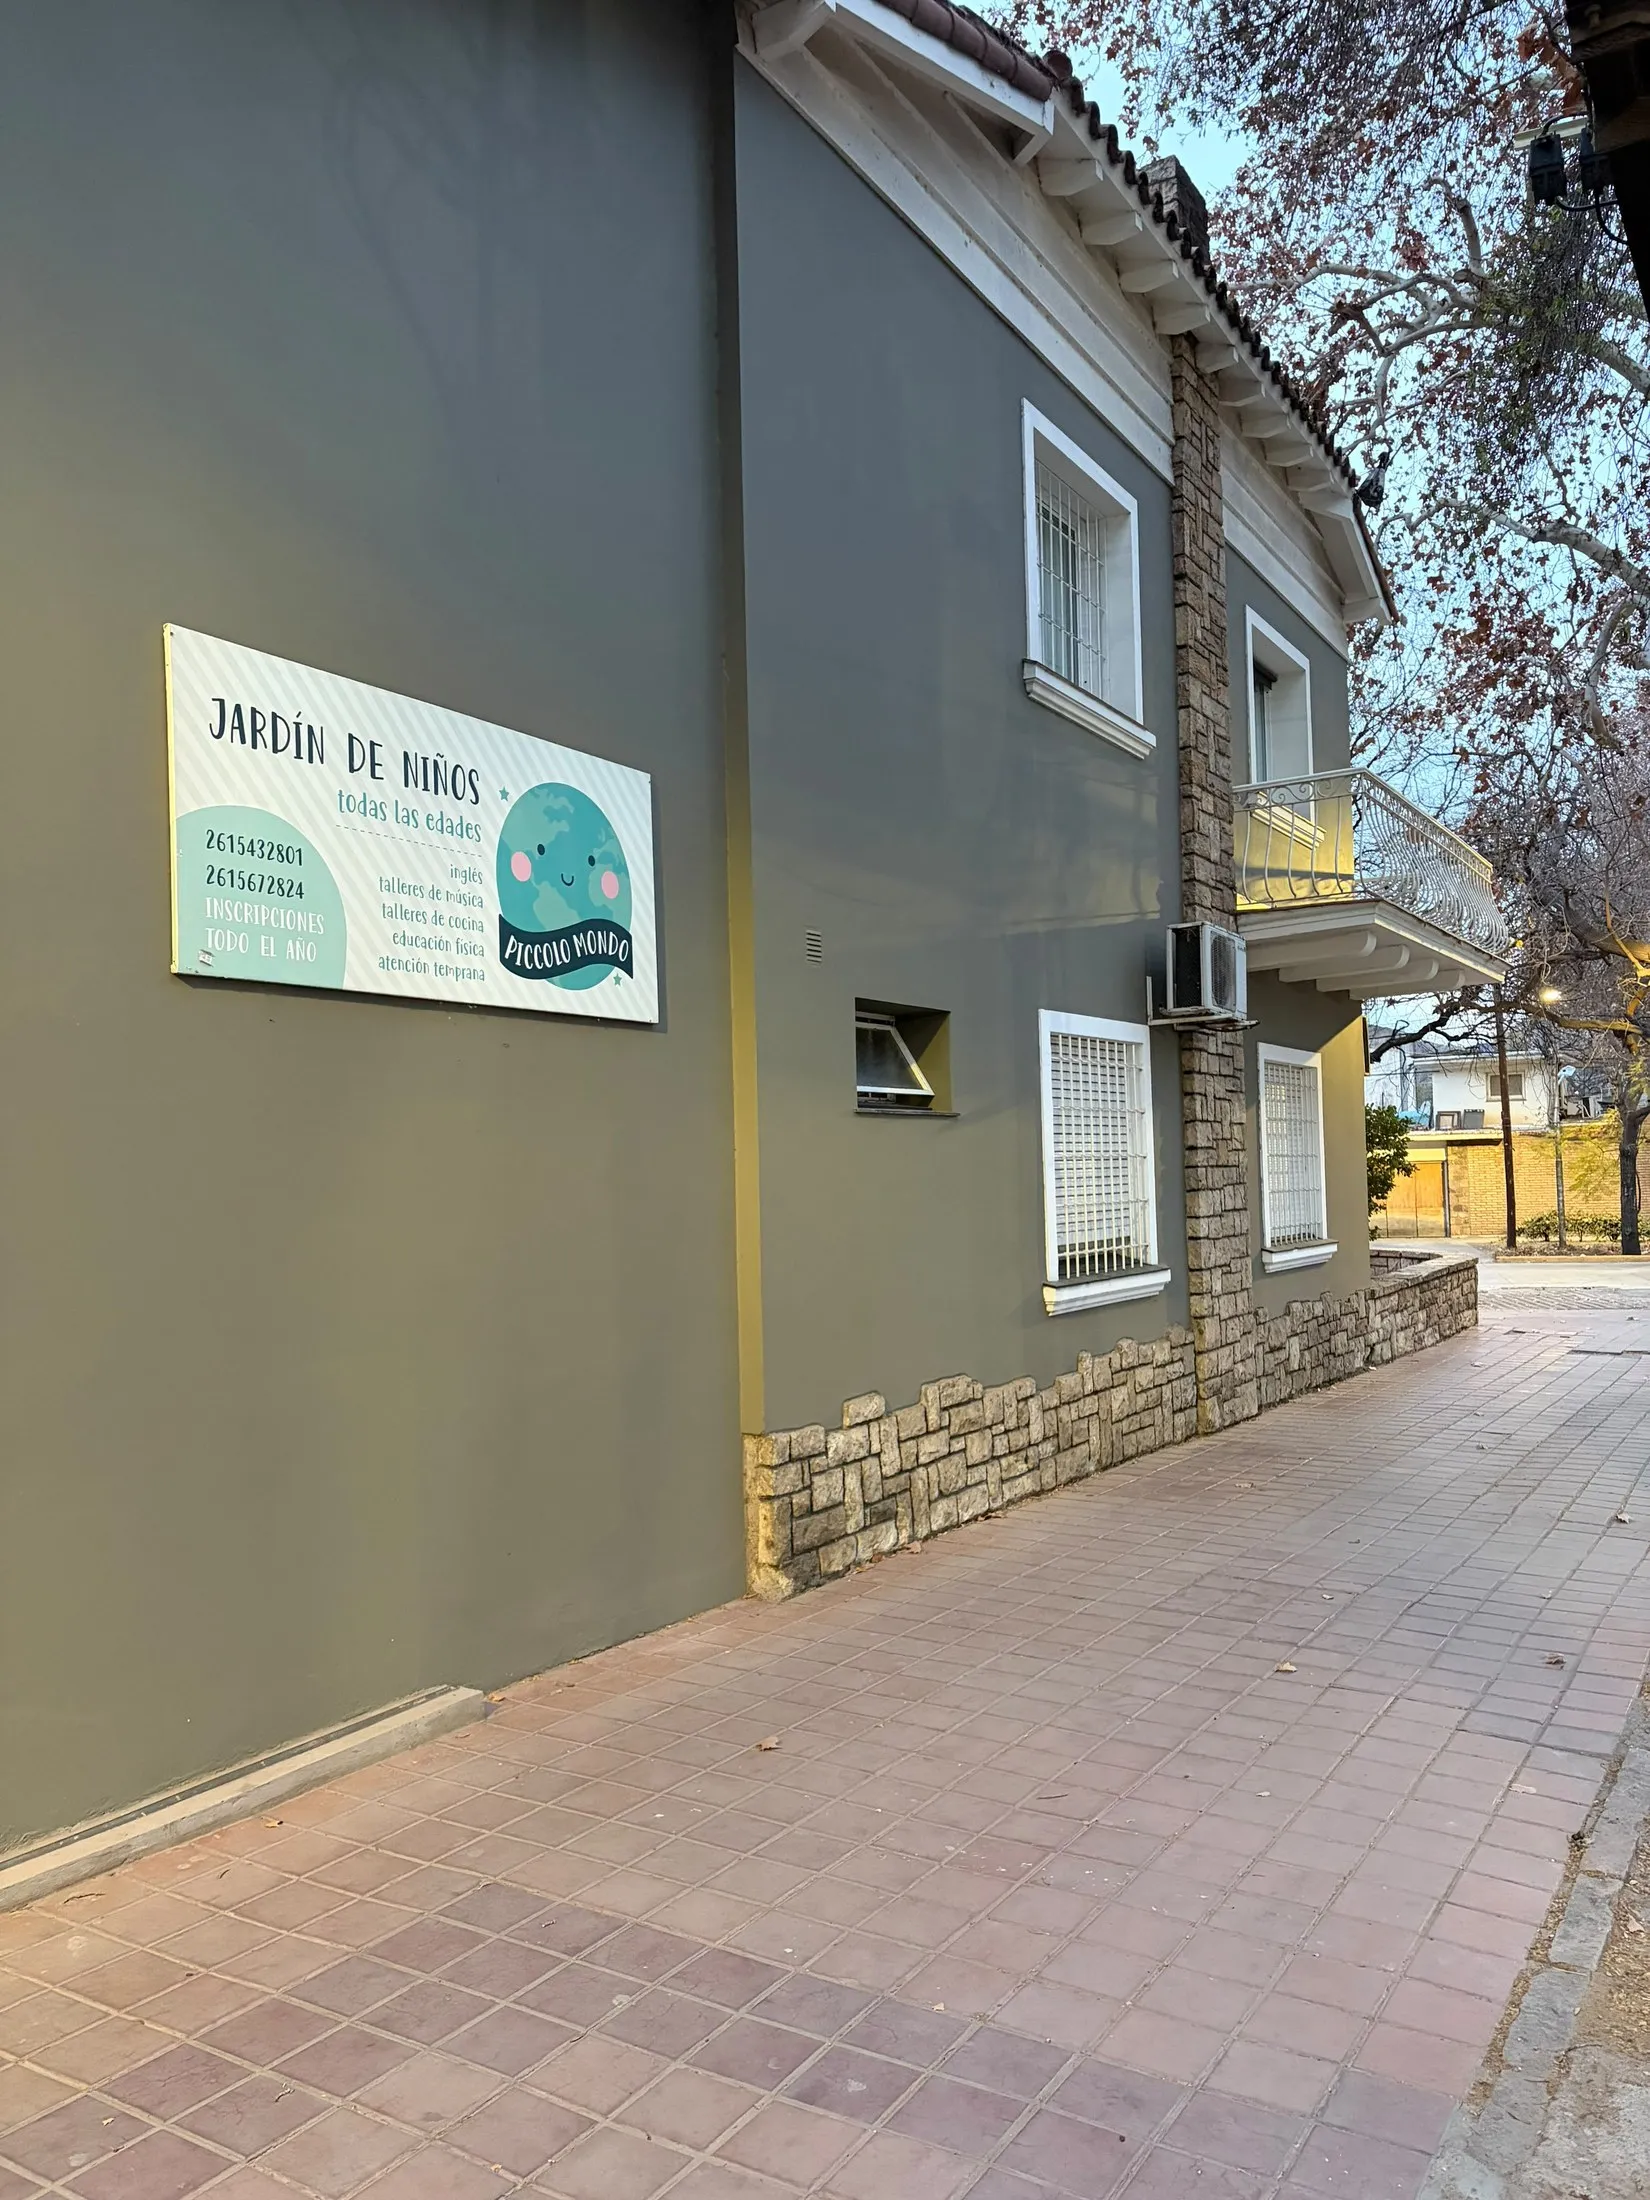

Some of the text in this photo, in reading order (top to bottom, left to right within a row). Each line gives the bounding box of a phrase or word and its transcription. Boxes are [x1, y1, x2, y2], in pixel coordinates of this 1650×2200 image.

[209, 697, 480, 805] JARDÍN DE NIÑOS
[337, 789, 482, 843] todas las edades
[206, 829, 303, 866] 2615432801
[206, 864, 305, 900] 2615672824
[450, 864, 483, 885] inglés
[379, 876, 484, 909] talleres de música
[205, 897, 325, 934] INSCRIPCIONES
[382, 903, 484, 934] talleres de cocina
[205, 927, 317, 962] TODO EL AÑO
[392, 931, 485, 958] educación física
[504, 930, 629, 970] PICCOLO MONDO
[378, 956, 485, 983] atención temprana
